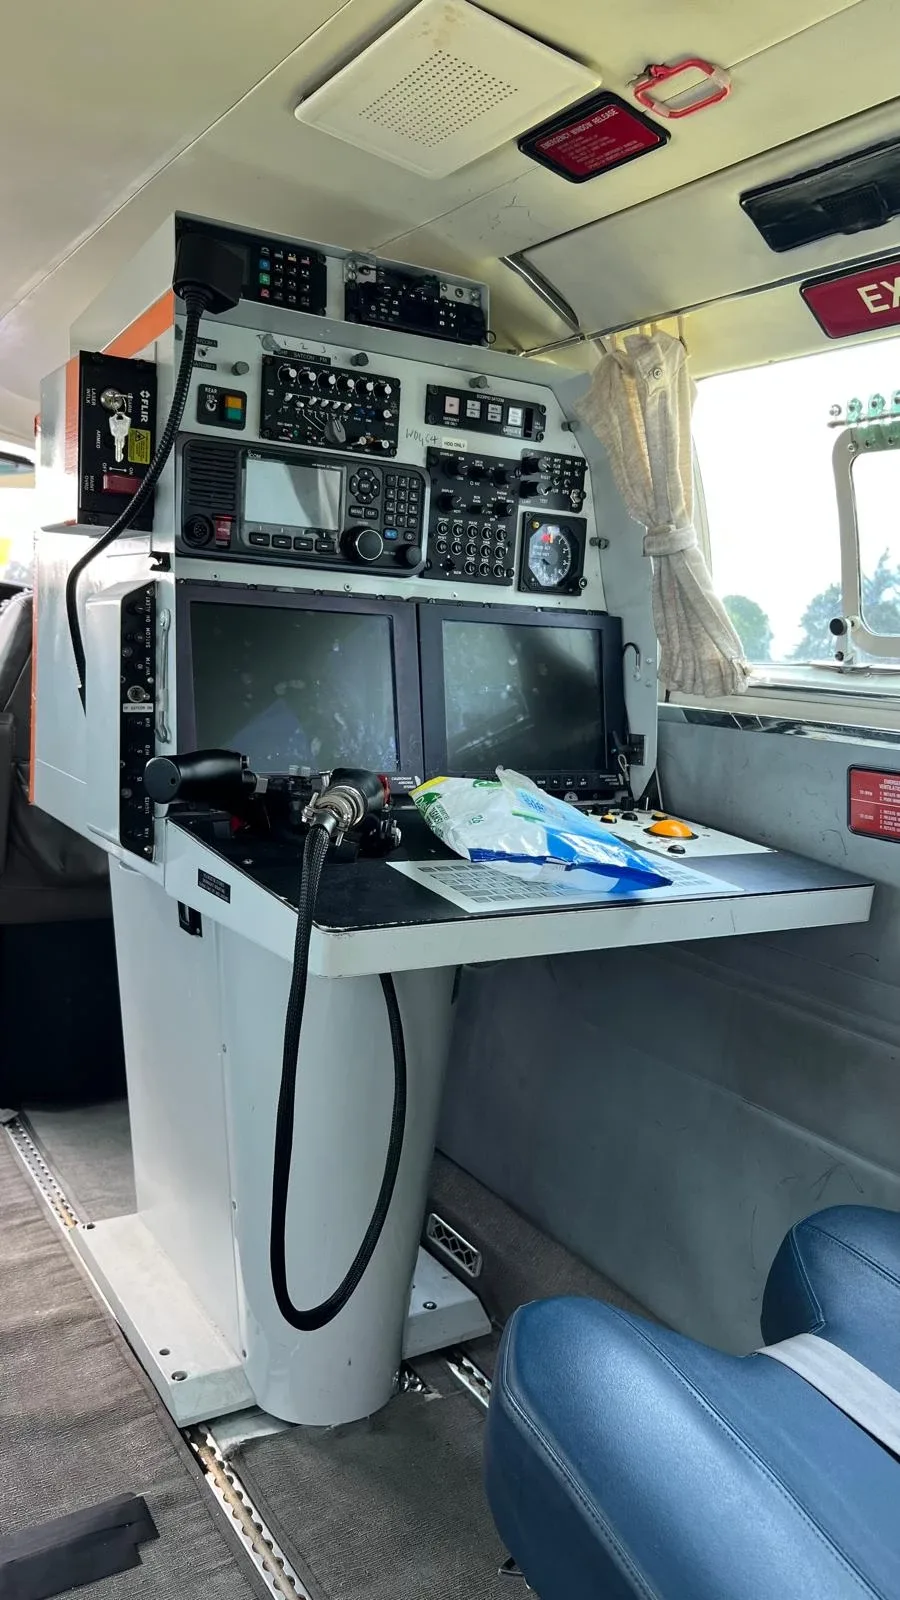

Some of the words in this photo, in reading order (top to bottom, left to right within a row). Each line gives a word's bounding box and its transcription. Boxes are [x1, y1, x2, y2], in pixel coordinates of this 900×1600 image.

[541, 133, 571, 150] EMERGENCY
[570, 121, 594, 136] WINDOW
[591, 108, 619, 126] RELEASE
[140, 398, 149, 423] FLIR
